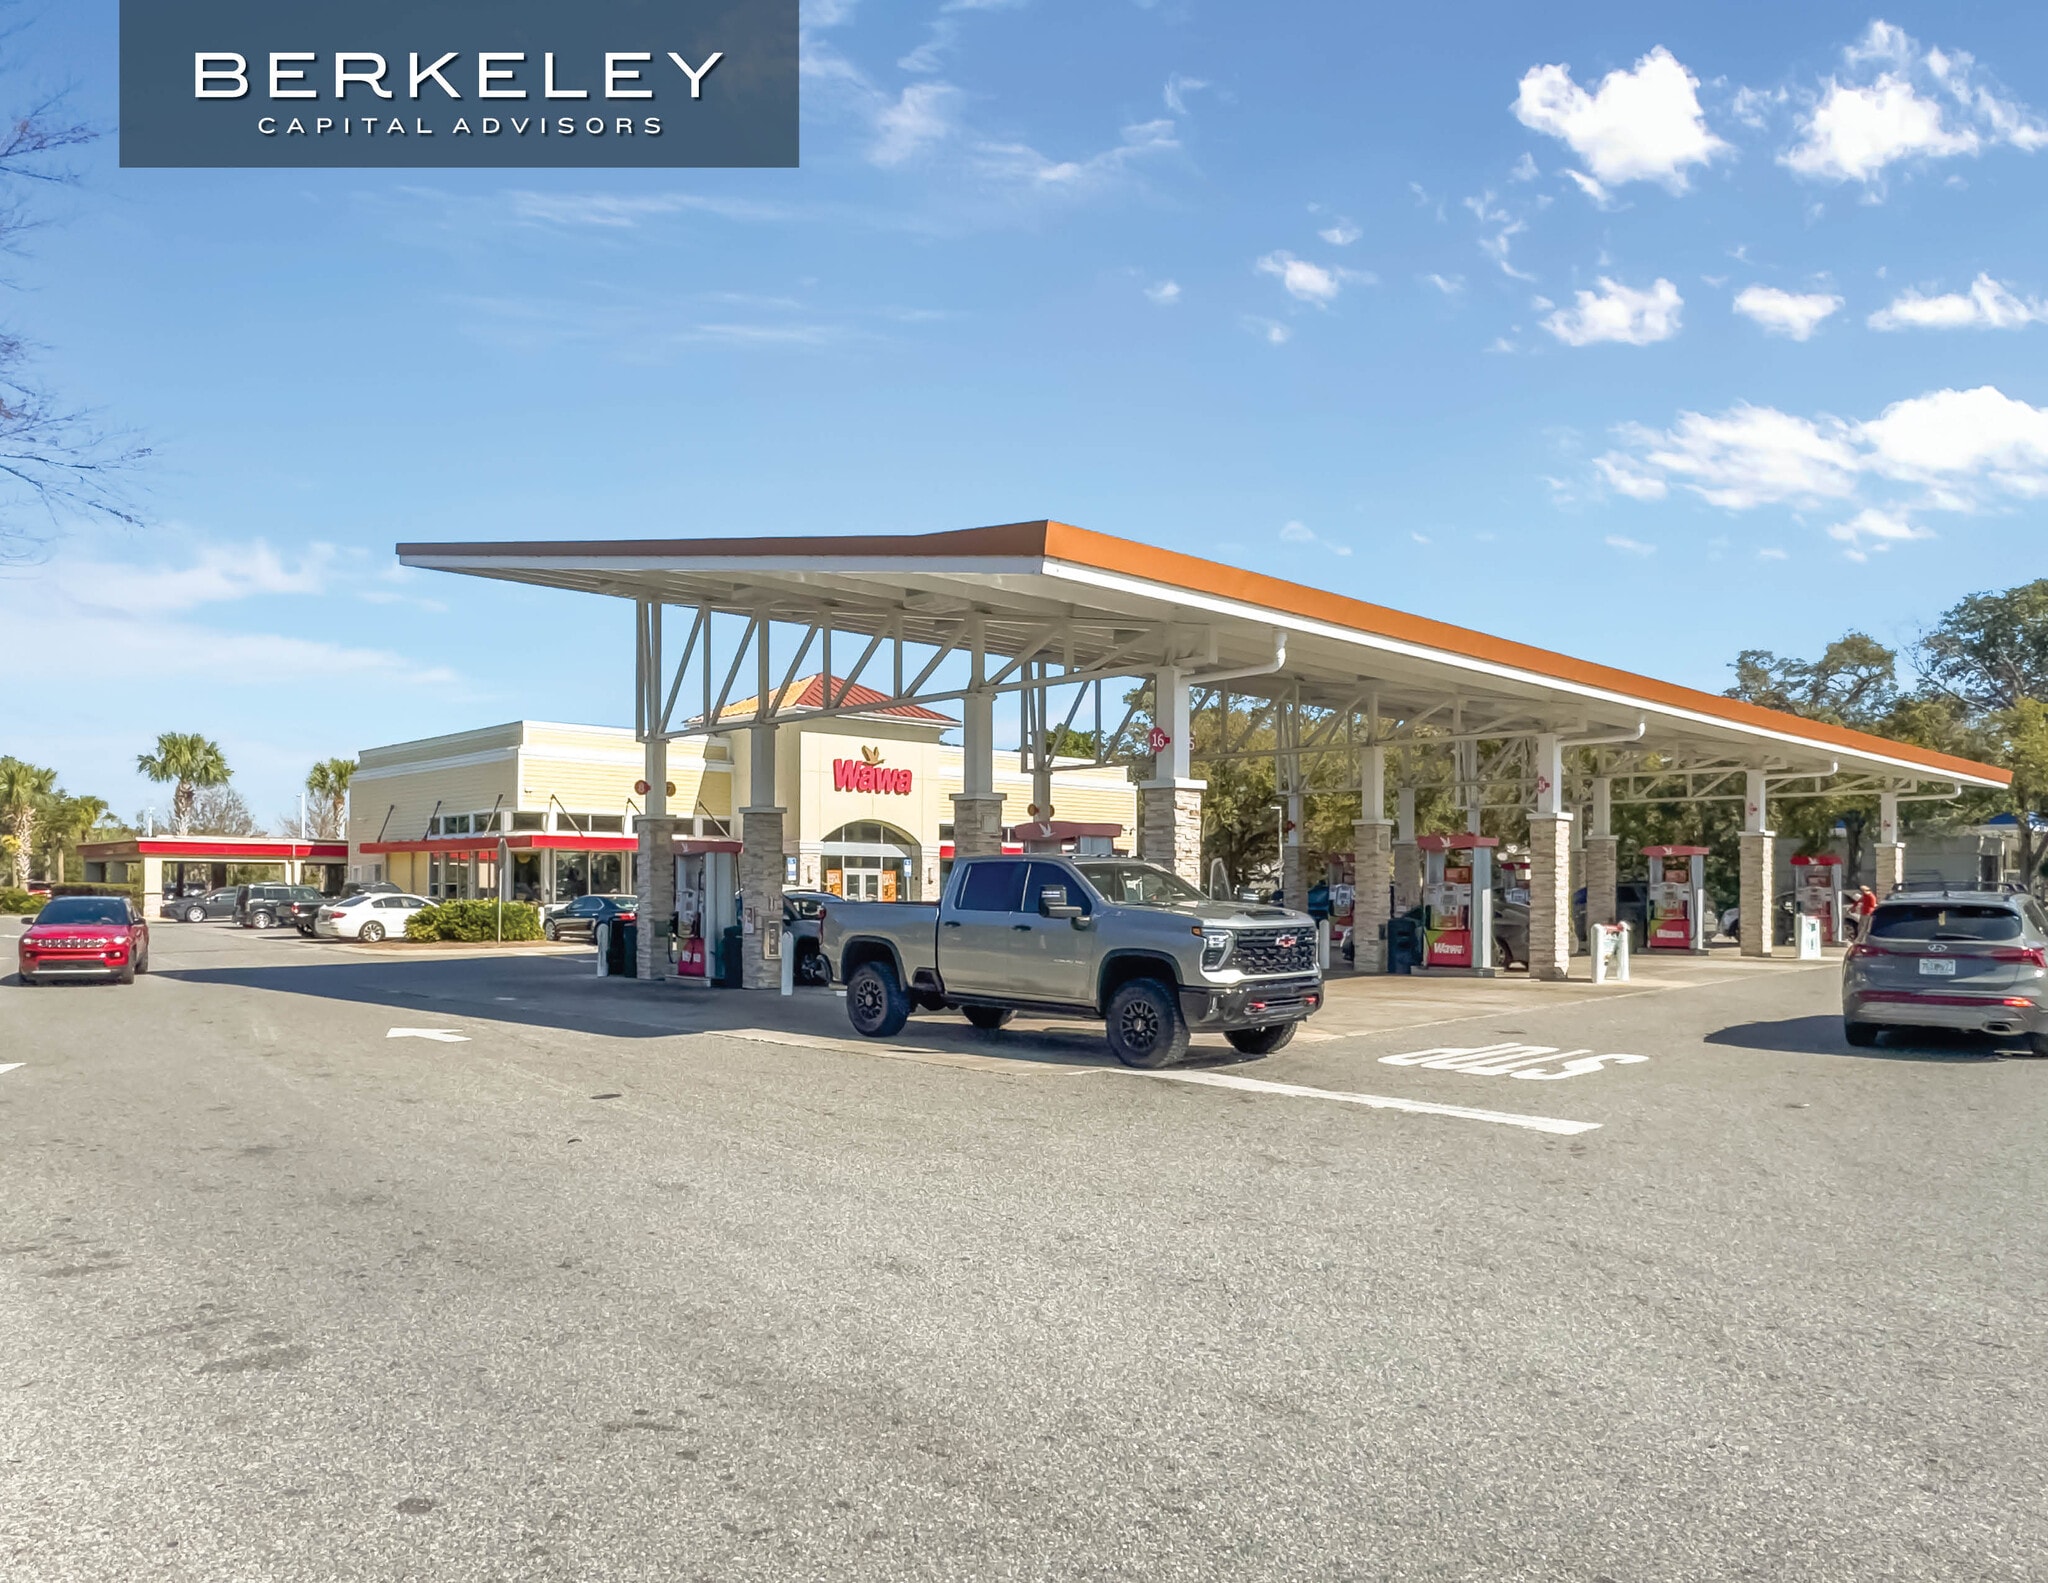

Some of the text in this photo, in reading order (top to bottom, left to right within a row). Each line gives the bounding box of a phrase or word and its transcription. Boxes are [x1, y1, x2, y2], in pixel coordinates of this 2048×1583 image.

[1152, 733, 1164, 748] 16
[833, 758, 912, 796] Wawa
[1377, 1042, 1650, 1080] STOP
